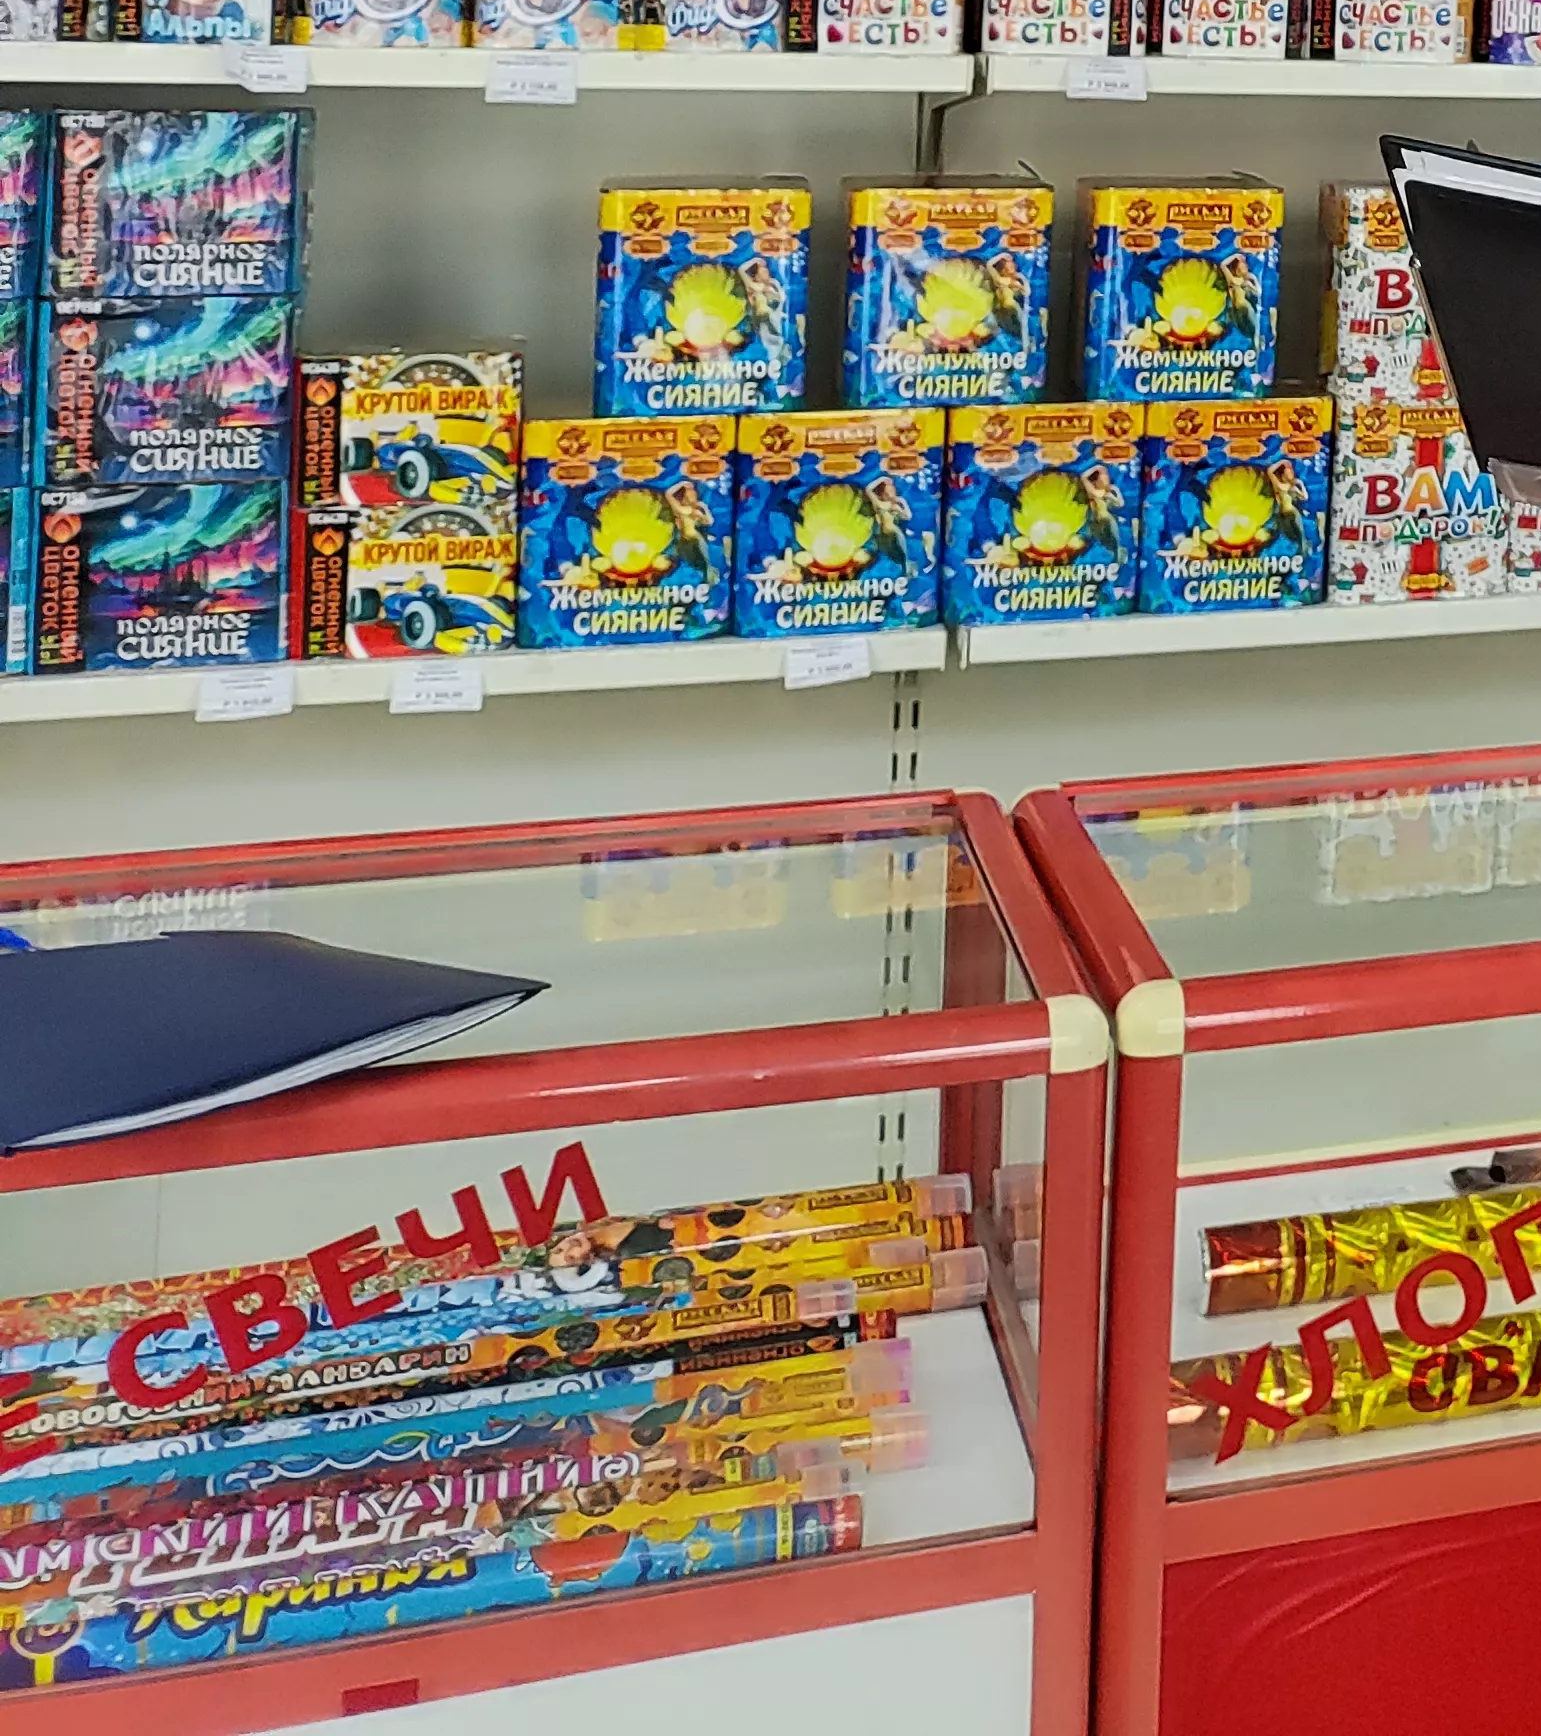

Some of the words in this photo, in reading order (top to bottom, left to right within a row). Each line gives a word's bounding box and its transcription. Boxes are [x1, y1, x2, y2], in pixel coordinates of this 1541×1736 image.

[147, 12, 253, 38] АЛЬПЫ
[848, 20, 930, 45] ЕСТЬ!
[1005, 21, 1089, 46] ЕСТЬ!
[1187, 24, 1267, 48] ЕСТЬ!
[1359, 30, 1437, 53] ЕСТЬ!
[133, 261, 265, 287] СИЯНИЕ
[624, 358, 782, 383] Жемчужное
[875, 348, 1028, 374] Жемчужное
[1114, 346, 1258, 370] Жемчужное
[647, 381, 759, 409] СИЯНИЕ
[898, 372, 1006, 399] СИЯНИЕ
[1134, 369, 1235, 394] СИЯНИЕ
[355, 386, 432, 415] КРУТОЙ
[130, 445, 262, 474] СИЯНИЕ
[1363, 465, 1496, 516] ВАМ
[363, 537, 440, 566] КРУТОЙ
[445, 539, 514, 562] ВИРАЖ
[973, 563, 1120, 589] Жемчужное
[1164, 554, 1304, 579] Жемчужное
[40, 545, 60, 631] ЦВЕТОК
[549, 584, 710, 611] Жемчужное
[753, 576, 909, 604] Жемчужное
[994, 584, 1098, 613] СИЯНИЕ
[1183, 576, 1283, 604] СИЯНИЕ
[60, 544, 83, 663] ОГНЕННЫЙ
[775, 599, 886, 629] СИЯНИЕ
[573, 606, 686, 637] СИЯНИЕ
[117, 632, 250, 661] СИЯНИЕ
[105, 1139, 609, 1409] СВЕЧИ
